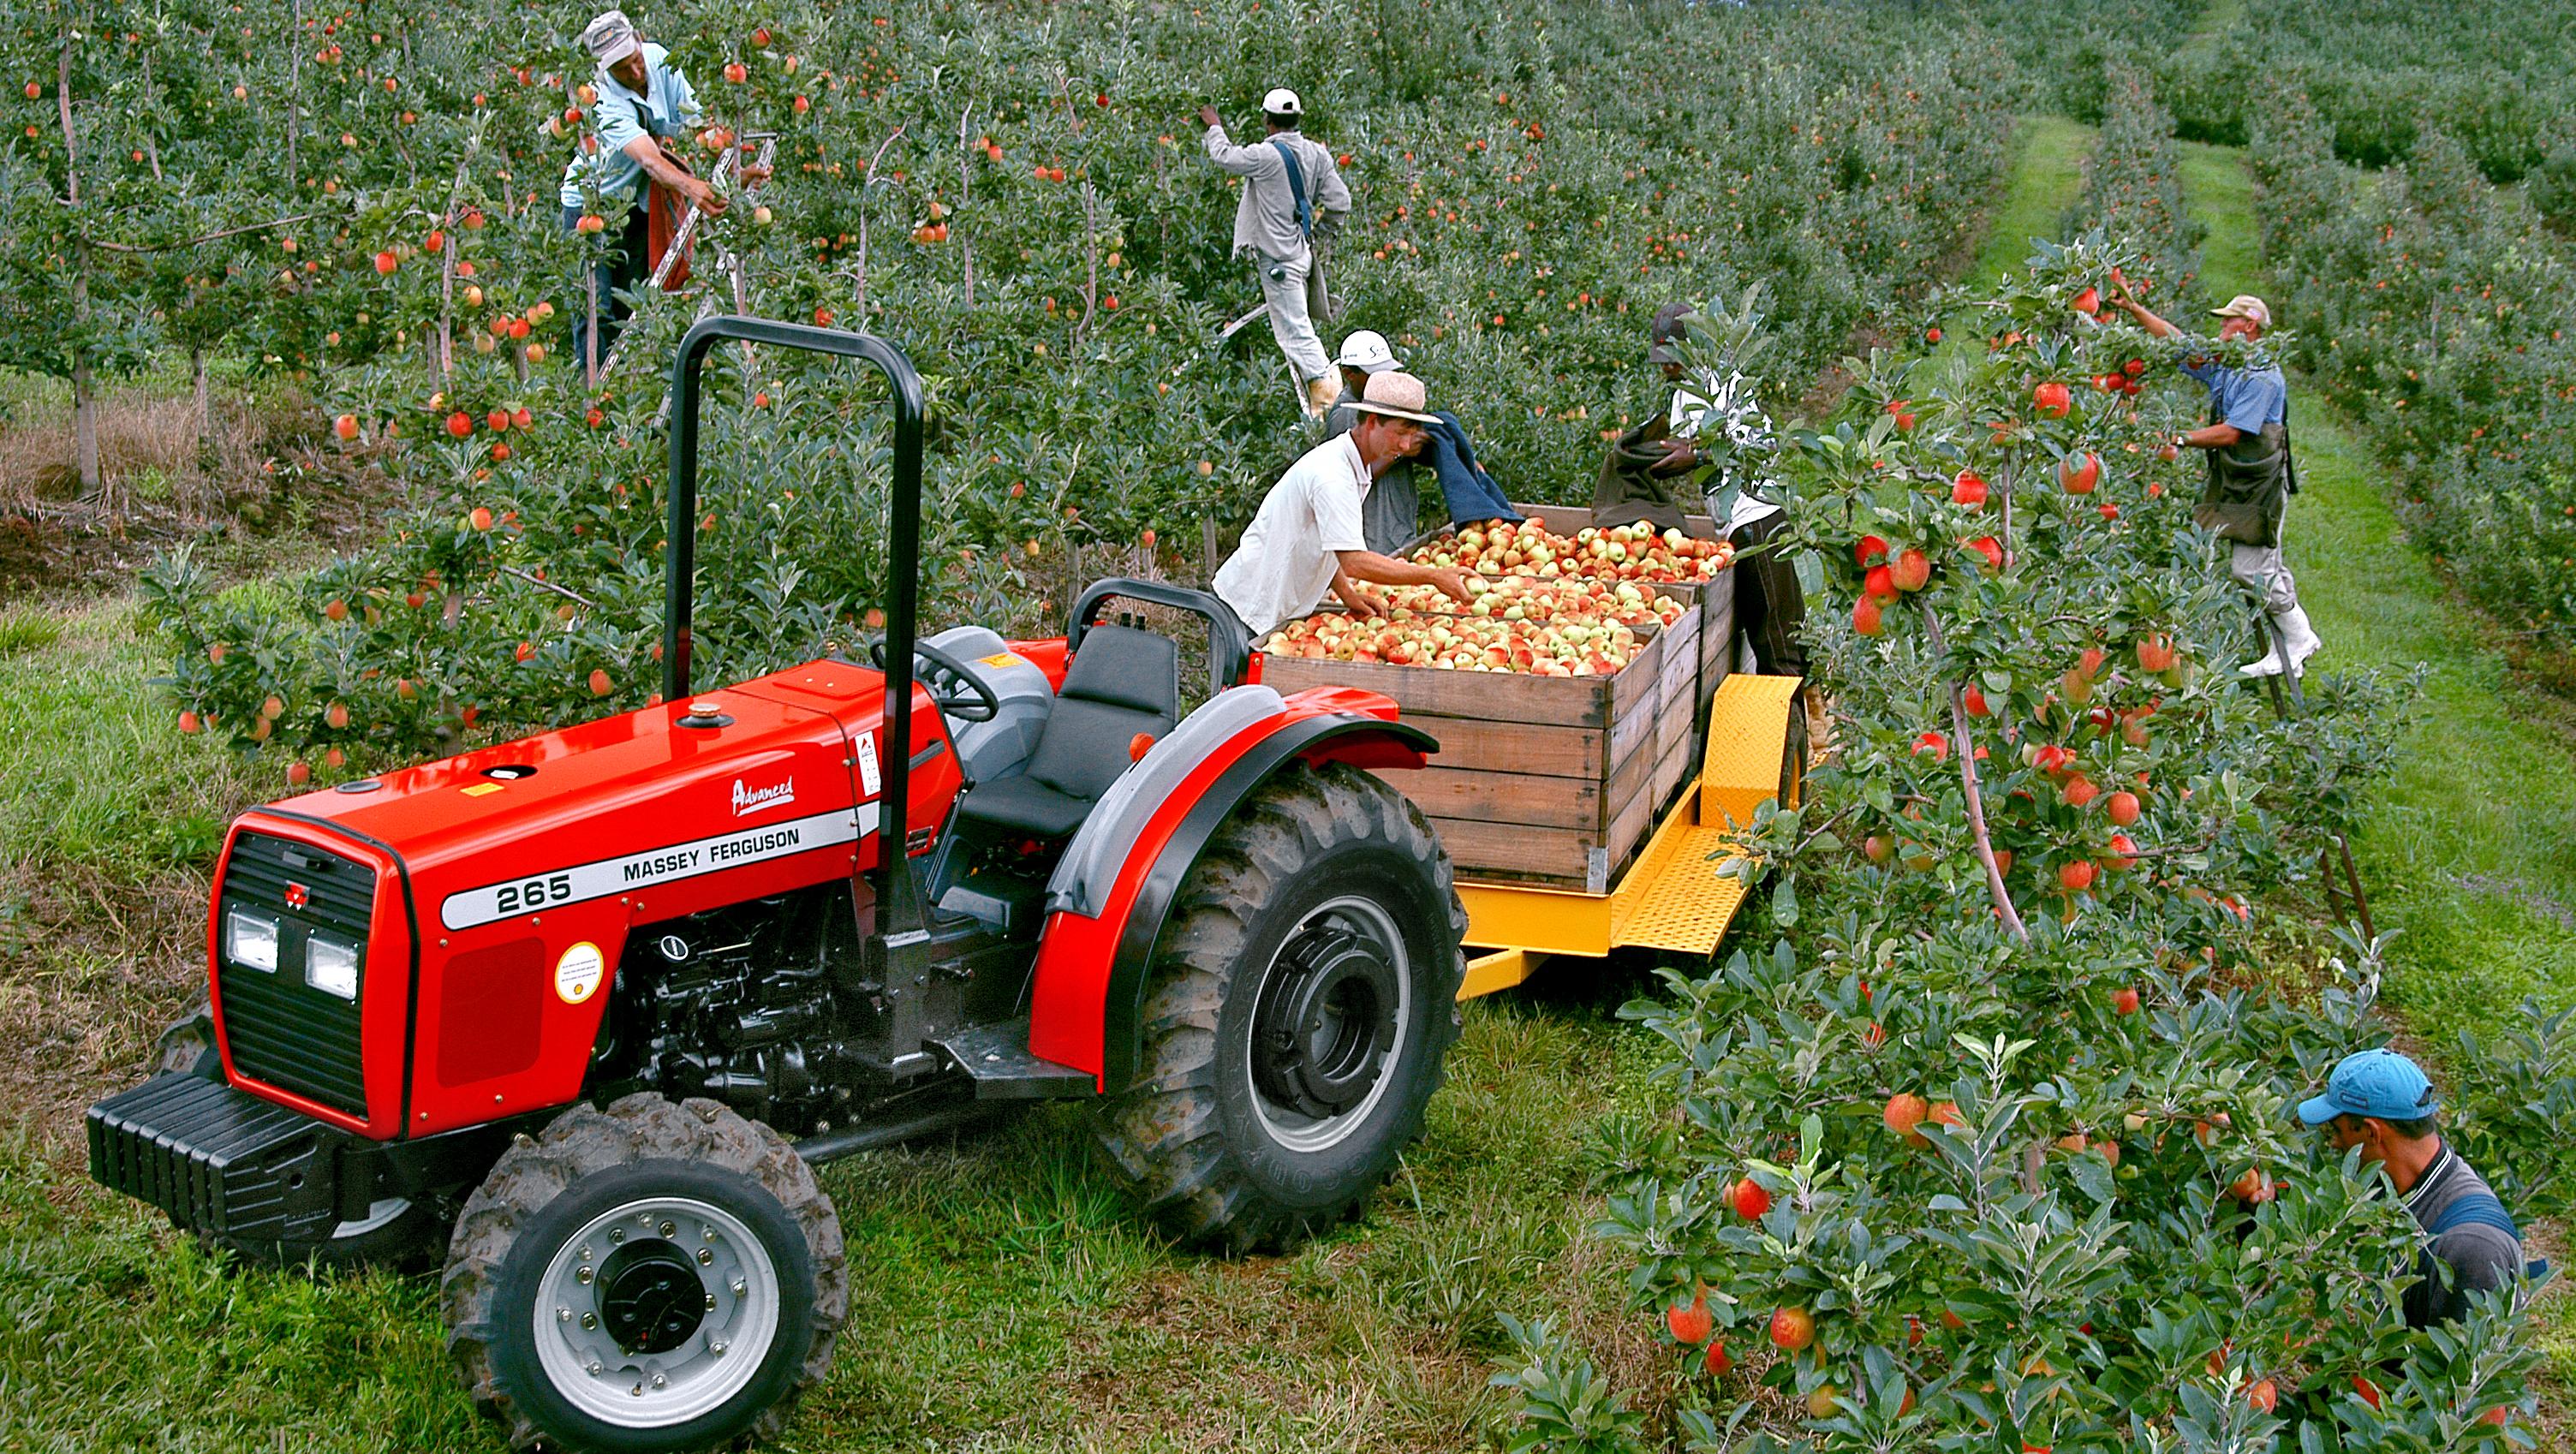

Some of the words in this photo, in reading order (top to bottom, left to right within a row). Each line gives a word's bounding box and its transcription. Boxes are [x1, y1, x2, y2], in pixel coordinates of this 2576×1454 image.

[730, 775, 795, 815] Advanced
[497, 874, 571, 914] 265
[623, 849, 700, 881] MASSEY
[710, 828, 800, 863] FERGUSON
